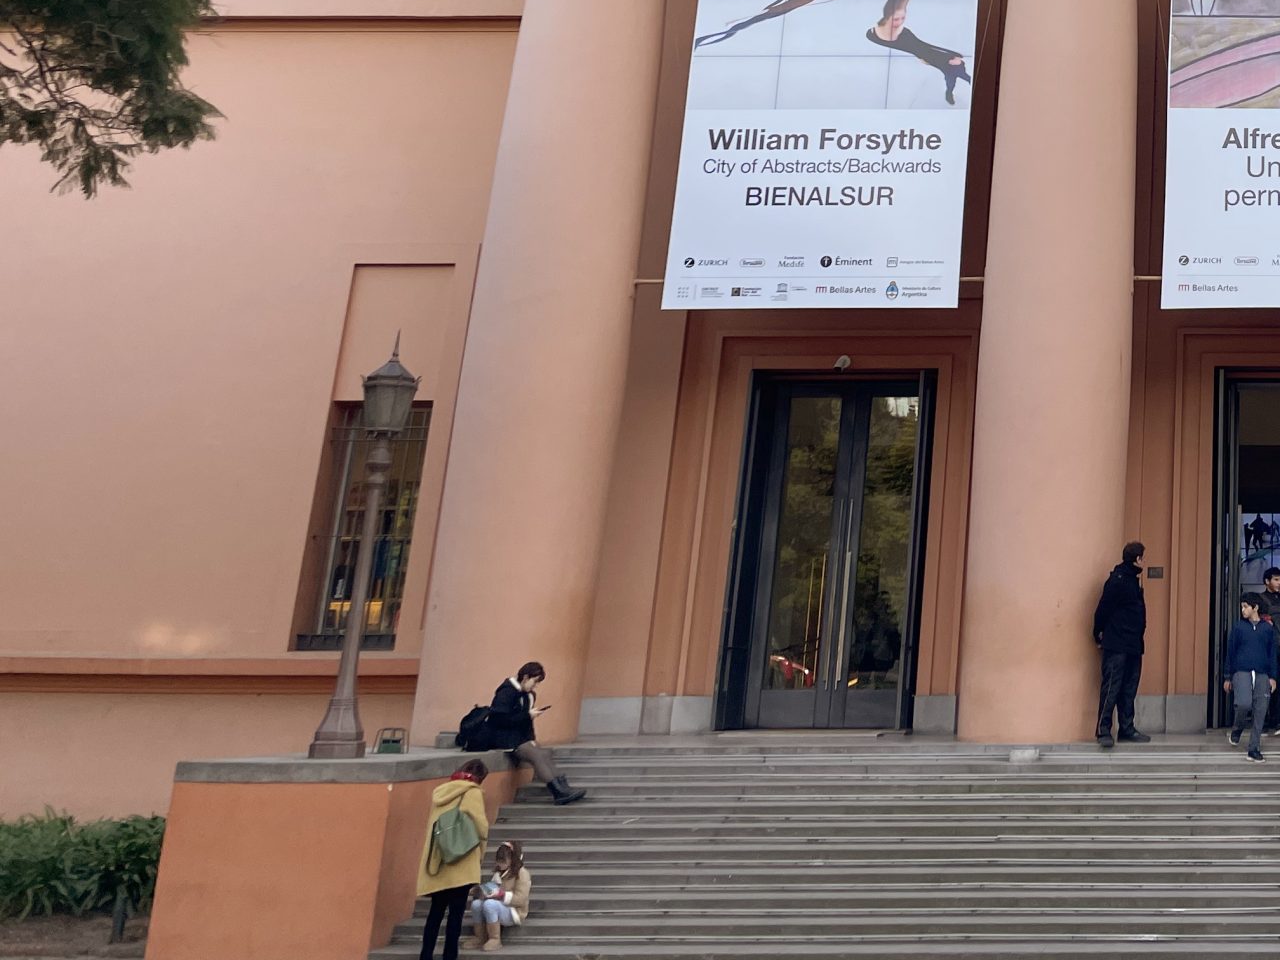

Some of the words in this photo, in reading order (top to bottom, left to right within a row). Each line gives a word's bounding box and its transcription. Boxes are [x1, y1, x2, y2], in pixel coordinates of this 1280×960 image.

[708, 128, 809, 150] William
[819, 128, 942, 155] Forsythe
[703, 158, 736, 177] City
[740, 158, 758, 174] of
[760, 158, 942, 174] Abstracts/Backwards
[745, 186, 894, 207] BIENALSUR
[835, 255, 873, 266] Éminent
[1192, 257, 1222, 265] ZURICH
[829, 286, 854, 294] Bellas
[855, 286, 876, 294] Artes
[1192, 284, 1216, 292] Bellas
[1217, 284, 1239, 292] Artes
